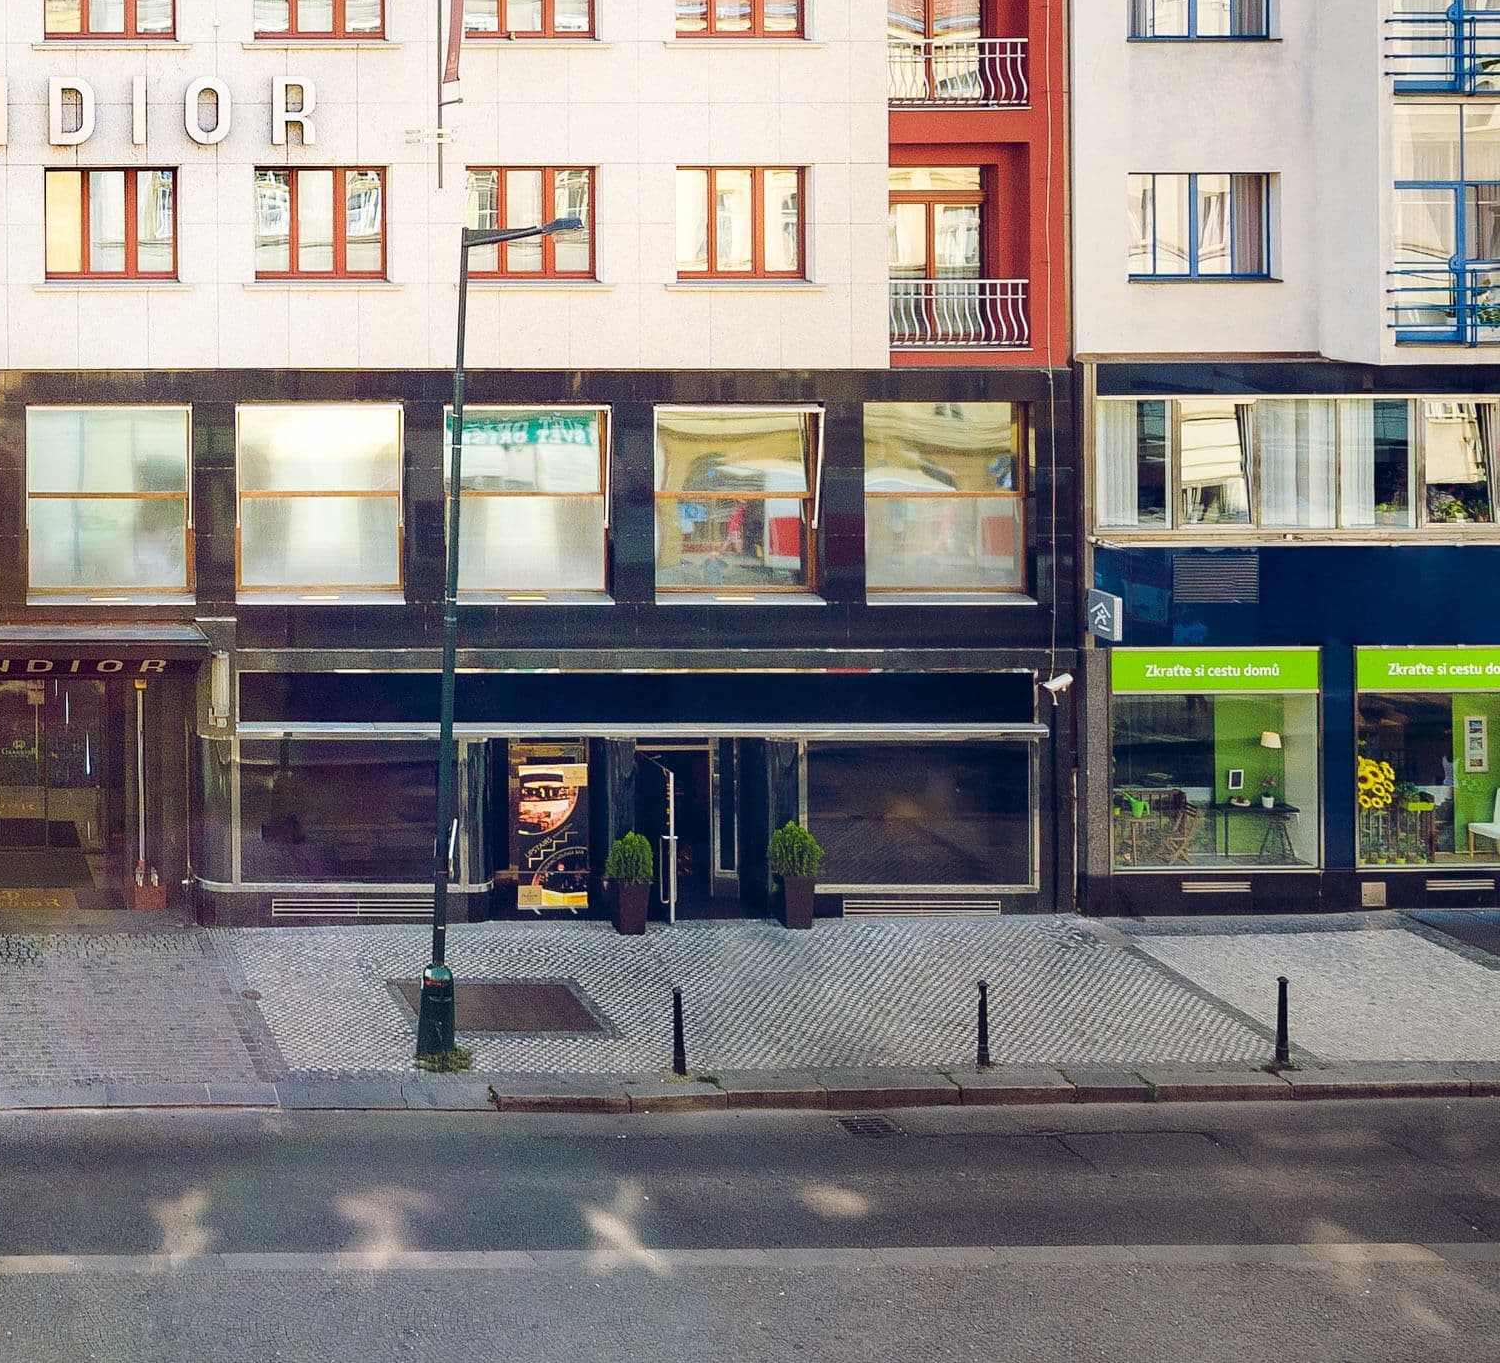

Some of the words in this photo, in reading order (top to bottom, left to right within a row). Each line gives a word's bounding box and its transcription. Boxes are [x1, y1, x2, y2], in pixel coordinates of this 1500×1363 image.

[1145, 664, 1192, 677] Zkraťte
[1195, 664, 1205, 677] si
[1208, 664, 1241, 677] cestu
[1244, 663, 1280, 677] domů
[1387, 662, 1434, 676] Zkraťte
[1437, 662, 1447, 675] si
[1450, 663, 1483, 676] cestu
